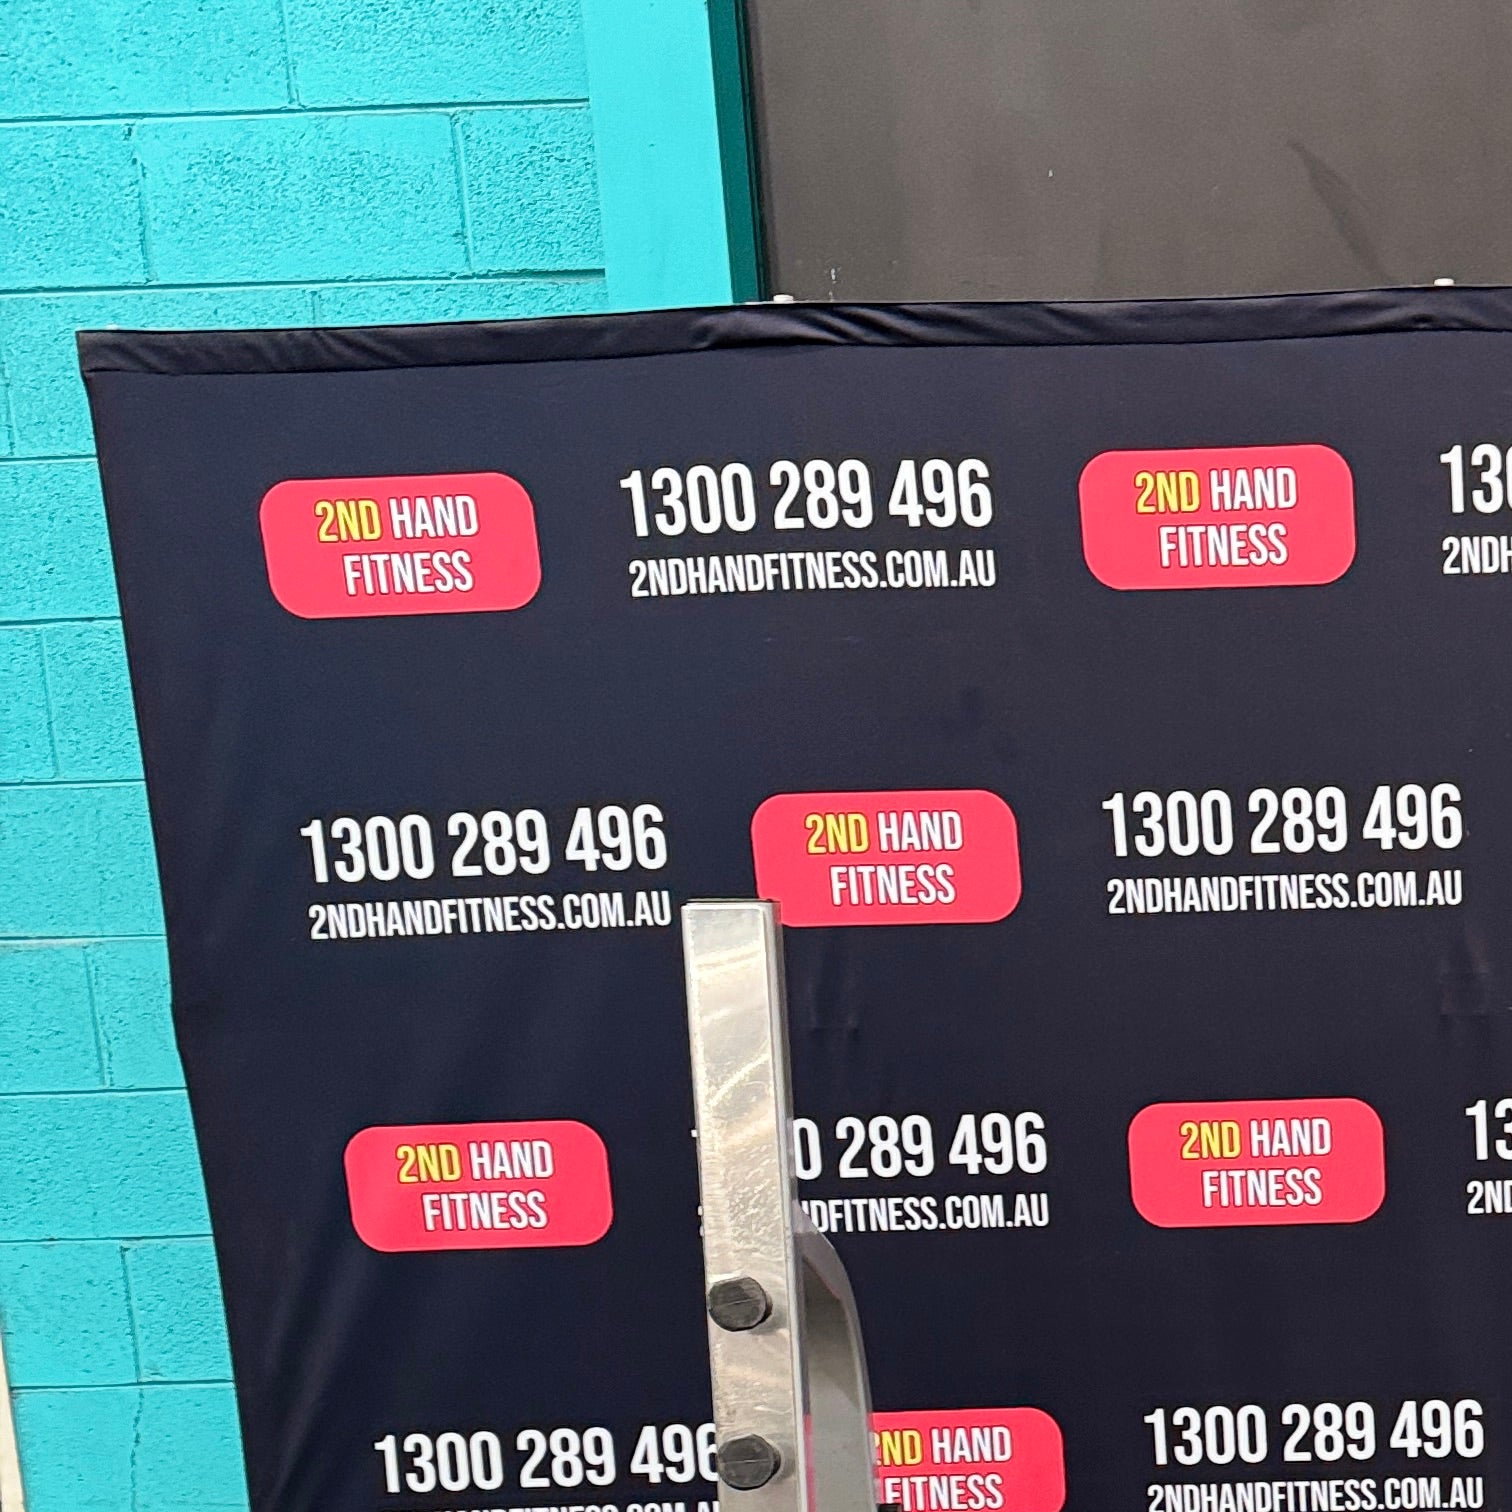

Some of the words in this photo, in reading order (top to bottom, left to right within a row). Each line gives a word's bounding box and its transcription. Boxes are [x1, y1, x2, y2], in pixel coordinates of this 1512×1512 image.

[619, 462, 757, 537] 1300
[769, 459, 873, 530] 289
[888, 458, 993, 528] 496
[1135, 471, 1200, 513] 2ND
[1210, 467, 1297, 511] HAND
[315, 500, 381, 542] 2ND
[389, 495, 479, 539] HAND
[1159, 523, 1288, 567] FITNESS
[343, 550, 473, 595] FITNESS
[628, 549, 996, 598] 2NDHANDFITNESS.COM.AU
[805, 813, 869, 854] 2ND
[877, 811, 963, 852] HAND
[1102, 789, 1234, 857] 1300
[1248, 786, 1348, 854] 289
[1362, 783, 1463, 850] 496
[300, 814, 435, 883] 1300
[447, 809, 551, 877] 289
[565, 803, 667, 872] 496
[830, 863, 956, 905] FITNESS
[1107, 869, 1463, 914] 2NDHANDFITNESS.COM.AU
[308, 890, 672, 940] 2NDHANDFITNESS.COM.AU
[835, 1114, 935, 1179] 289
[948, 1111, 1047, 1175] 496
[1180, 1121, 1241, 1159] 2ND
[1250, 1118, 1331, 1157] HAND
[396, 1144, 461, 1183] 2ND
[469, 1140, 554, 1180] HAND
[1202, 1167, 1322, 1207] FITNESS
[422, 1190, 547, 1231] FITNESS
[804, 1193, 1048, 1233] DFITNESS.COM.AU
[931, 1426, 1012, 1464] HAND
[1143, 1404, 1268, 1466] 1300
[1281, 1401, 1376, 1462] 289
[1389, 1399, 1484, 1458] 496
[374, 1430, 504, 1493] 1300
[516, 1426, 616, 1488] 289
[630, 1423, 719, 1483] 496
[884, 1473, 1004, 1512] FITNESS
